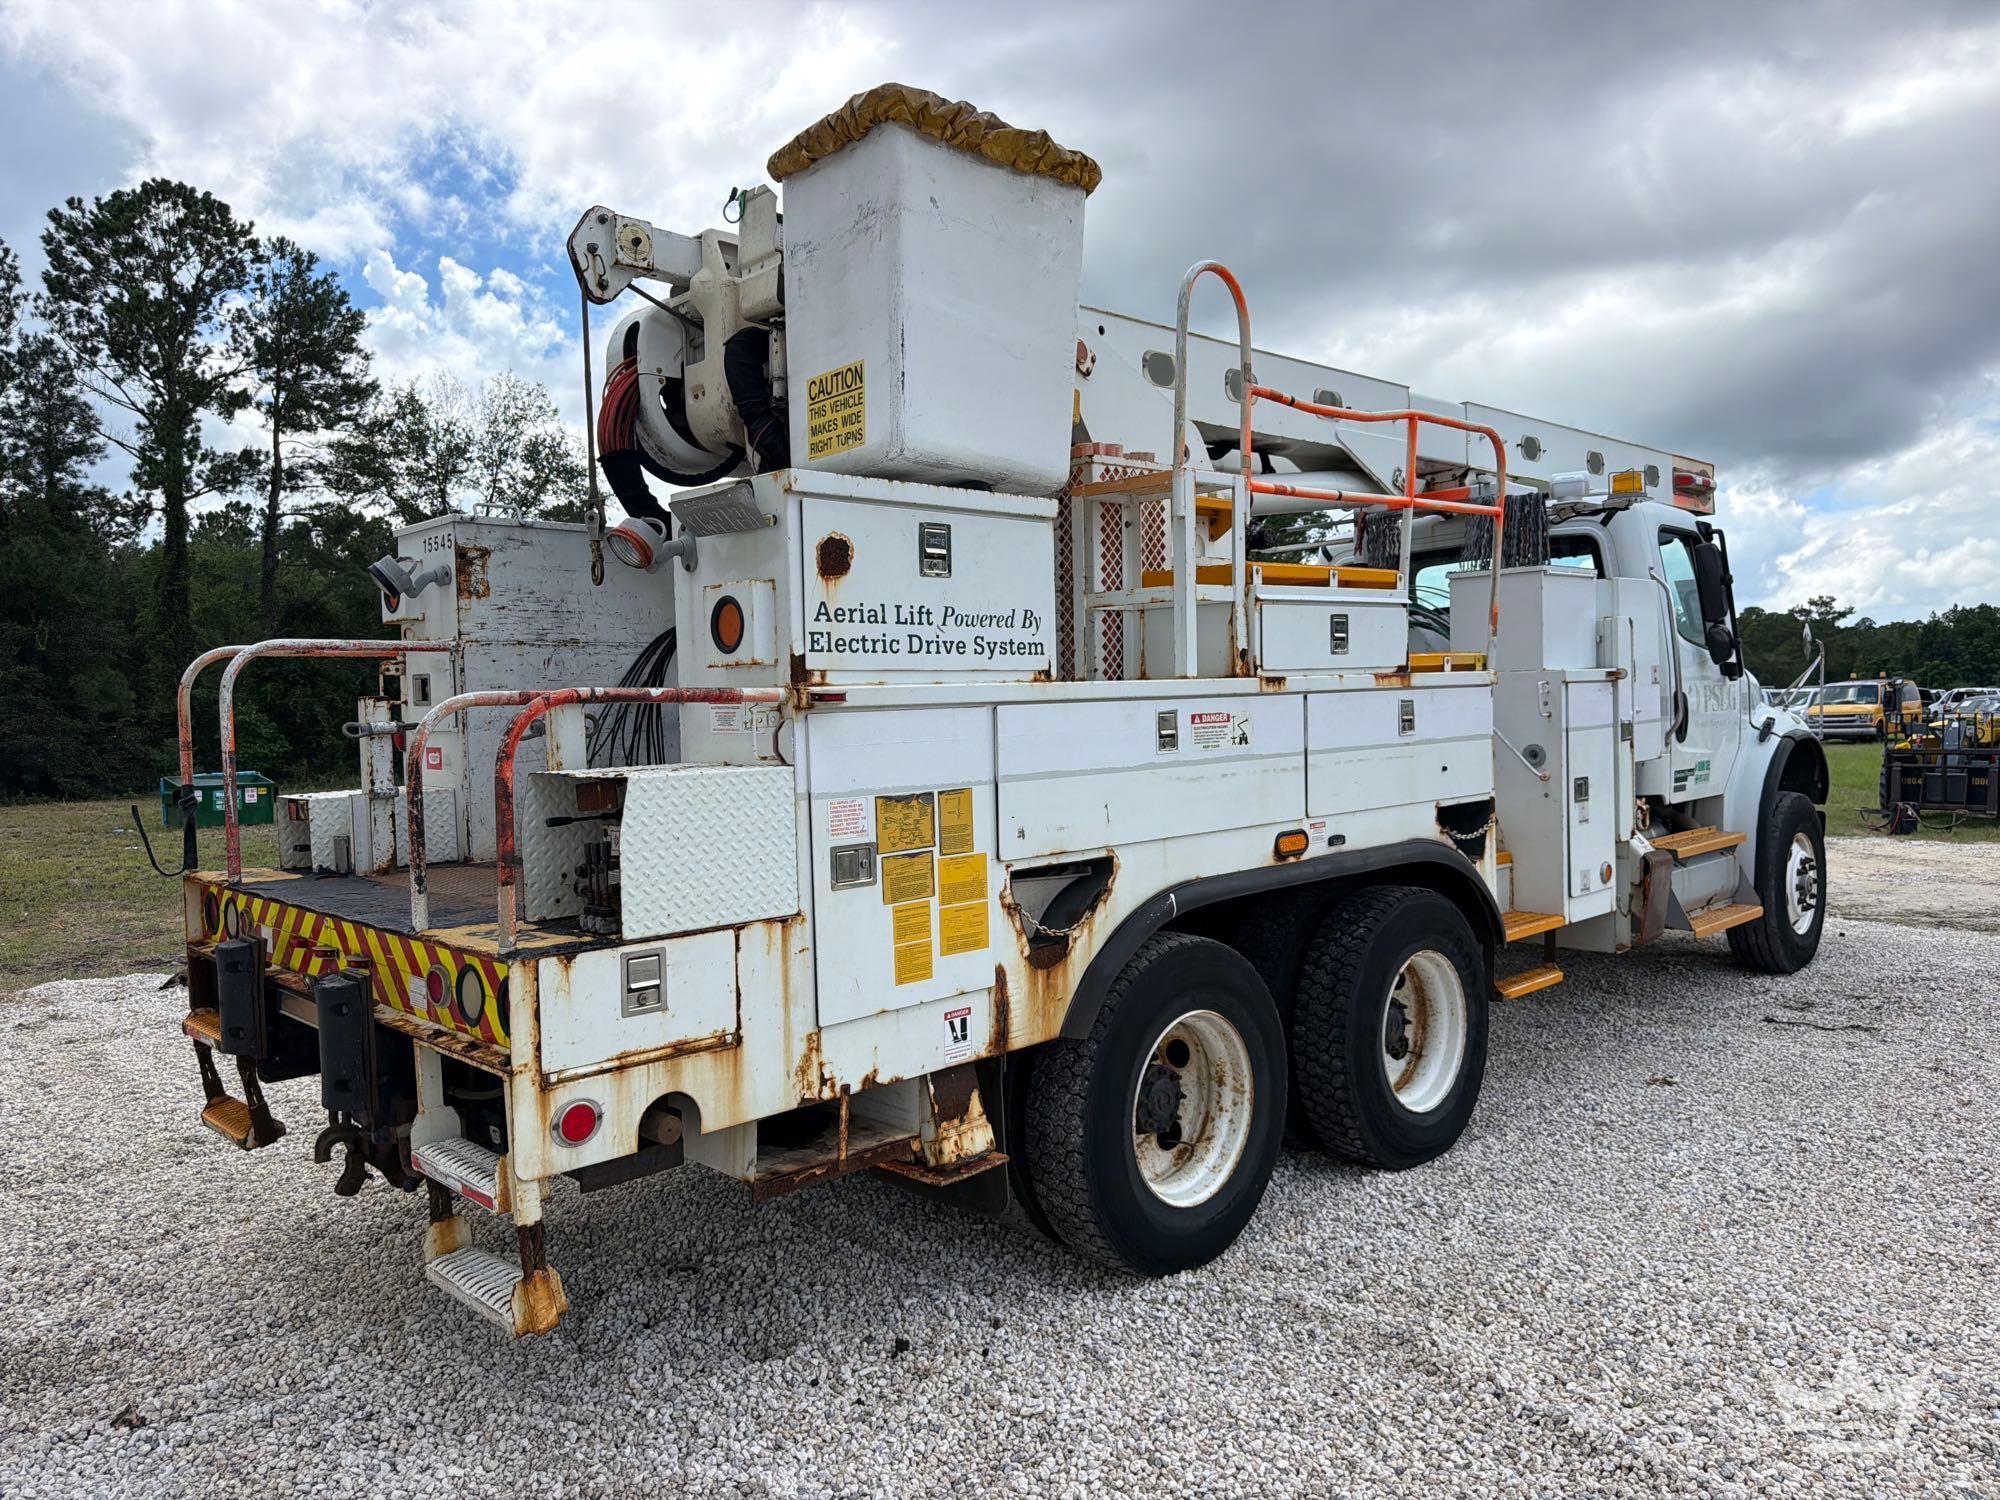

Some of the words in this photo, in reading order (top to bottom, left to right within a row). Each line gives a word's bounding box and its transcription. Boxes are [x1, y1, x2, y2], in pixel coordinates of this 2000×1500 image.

[809, 364, 863, 401] CAUTION
[810, 404, 826, 420] THIS
[830, 392, 863, 414] VEHICLE
[811, 418, 838, 437] MAKES
[841, 411, 862, 428] WIDE
[810, 437, 833, 455] RIGHT
[836, 428, 863, 447] TURNS
[423, 533, 452, 553] 15545
[814, 601, 887, 624] Aerial
[894, 604, 934, 626] Lift
[941, 606, 1016, 628] Powered
[1021, 609, 1041, 636] By
[808, 631, 900, 654] Electric
[907, 634, 966, 654] Drive
[974, 635, 1045, 660] System
[1202, 713, 1228, 723] DANGER
[951, 1009, 968, 1018] DANGER
